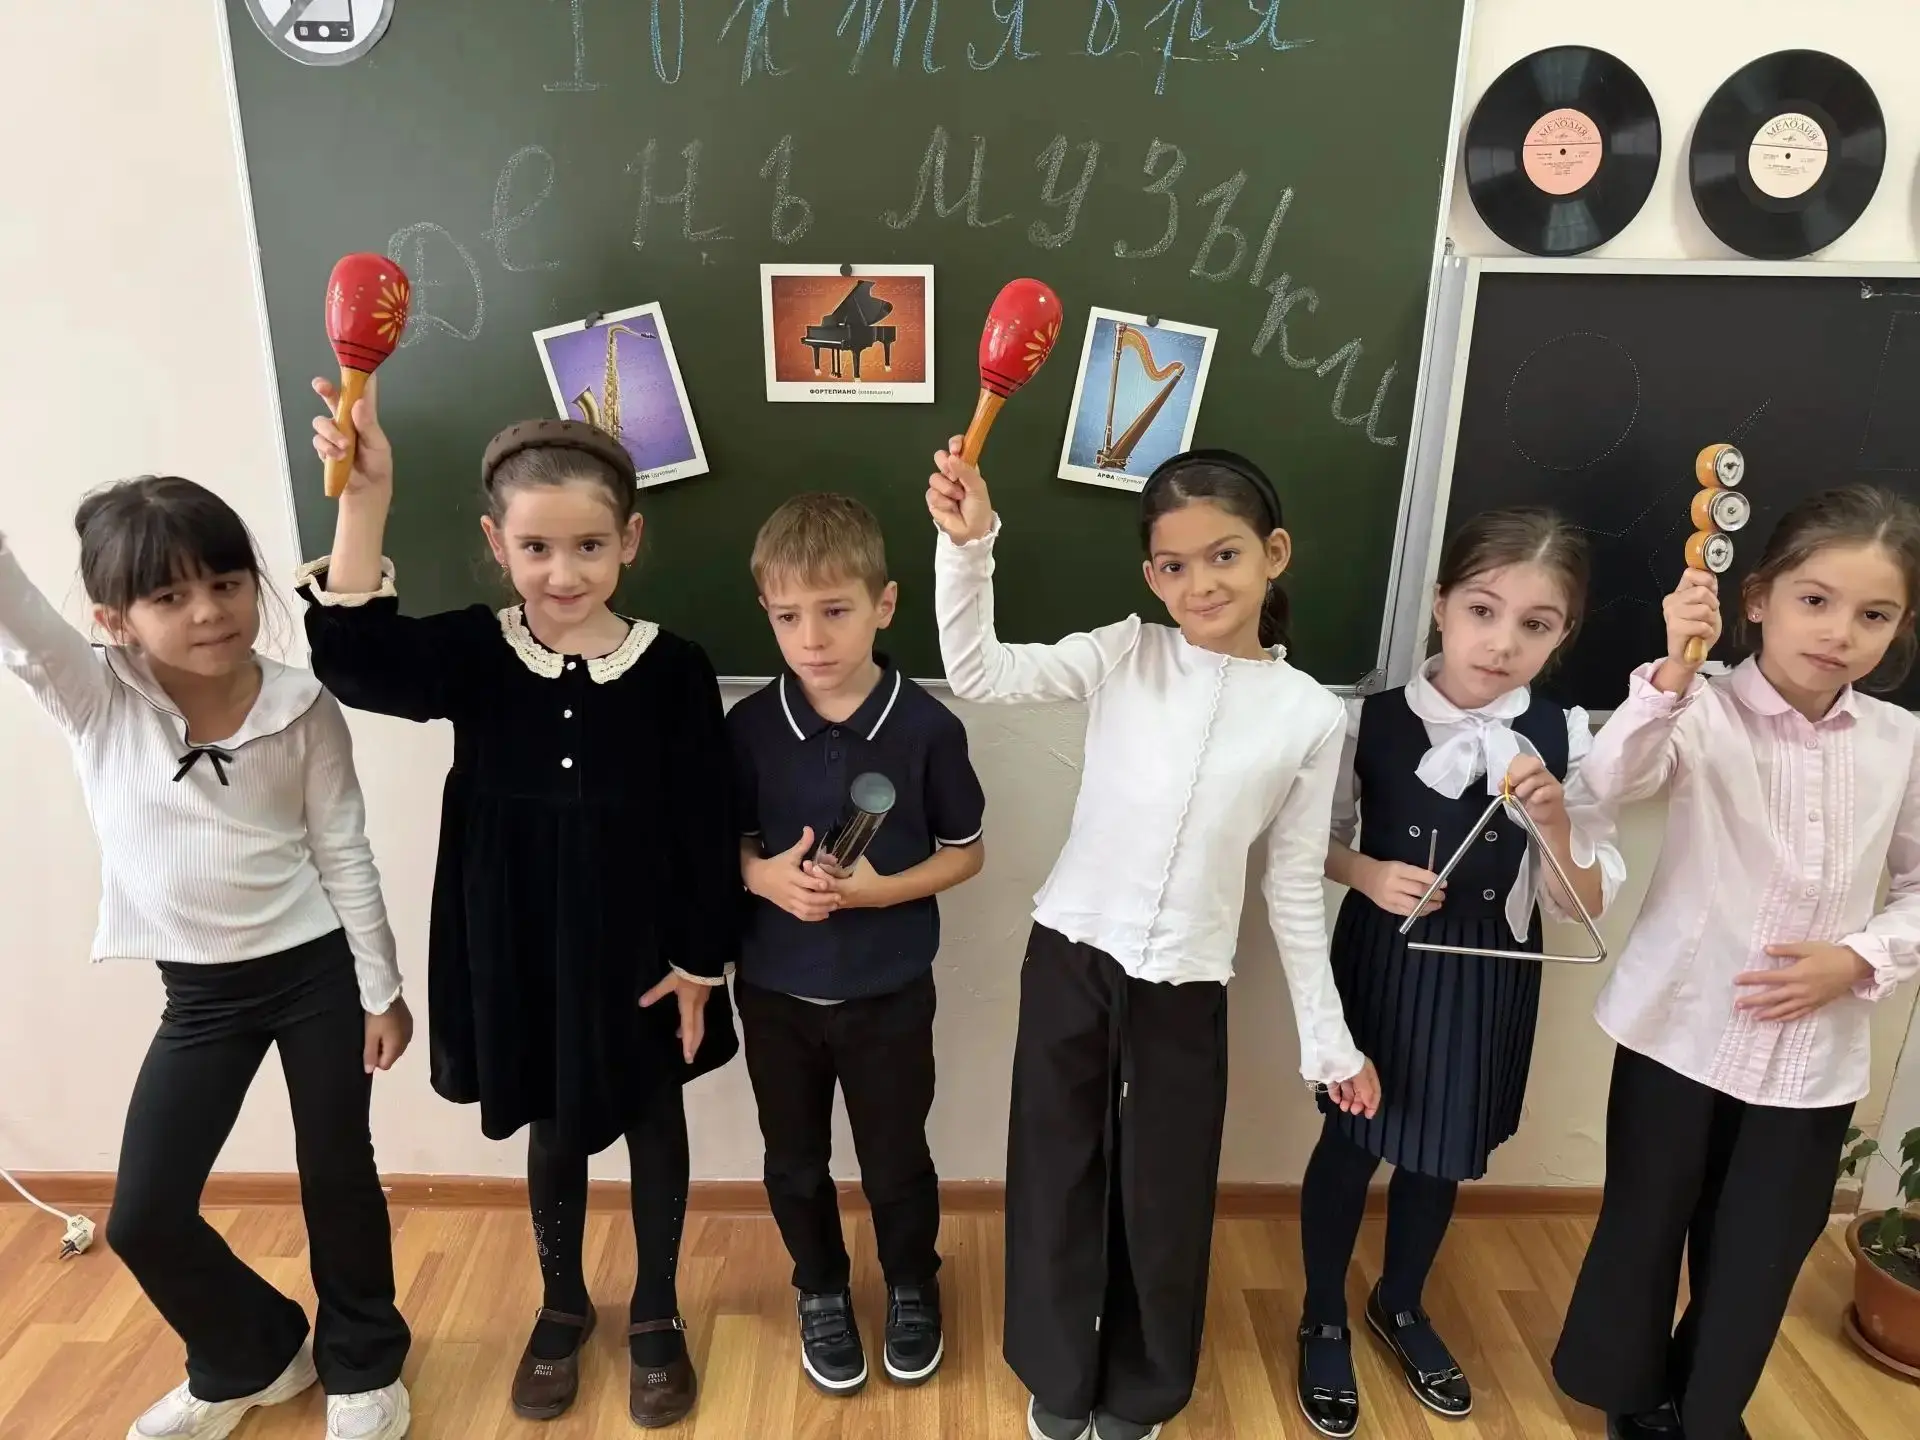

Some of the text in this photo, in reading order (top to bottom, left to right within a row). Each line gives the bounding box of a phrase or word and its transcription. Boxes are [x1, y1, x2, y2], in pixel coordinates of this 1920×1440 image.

[1540, 119, 1588, 137] МЕЛОДИЯ
[1766, 119, 1818, 141] МЕЛОДИЯ
[1097, 472, 1115, 480] АРФА
